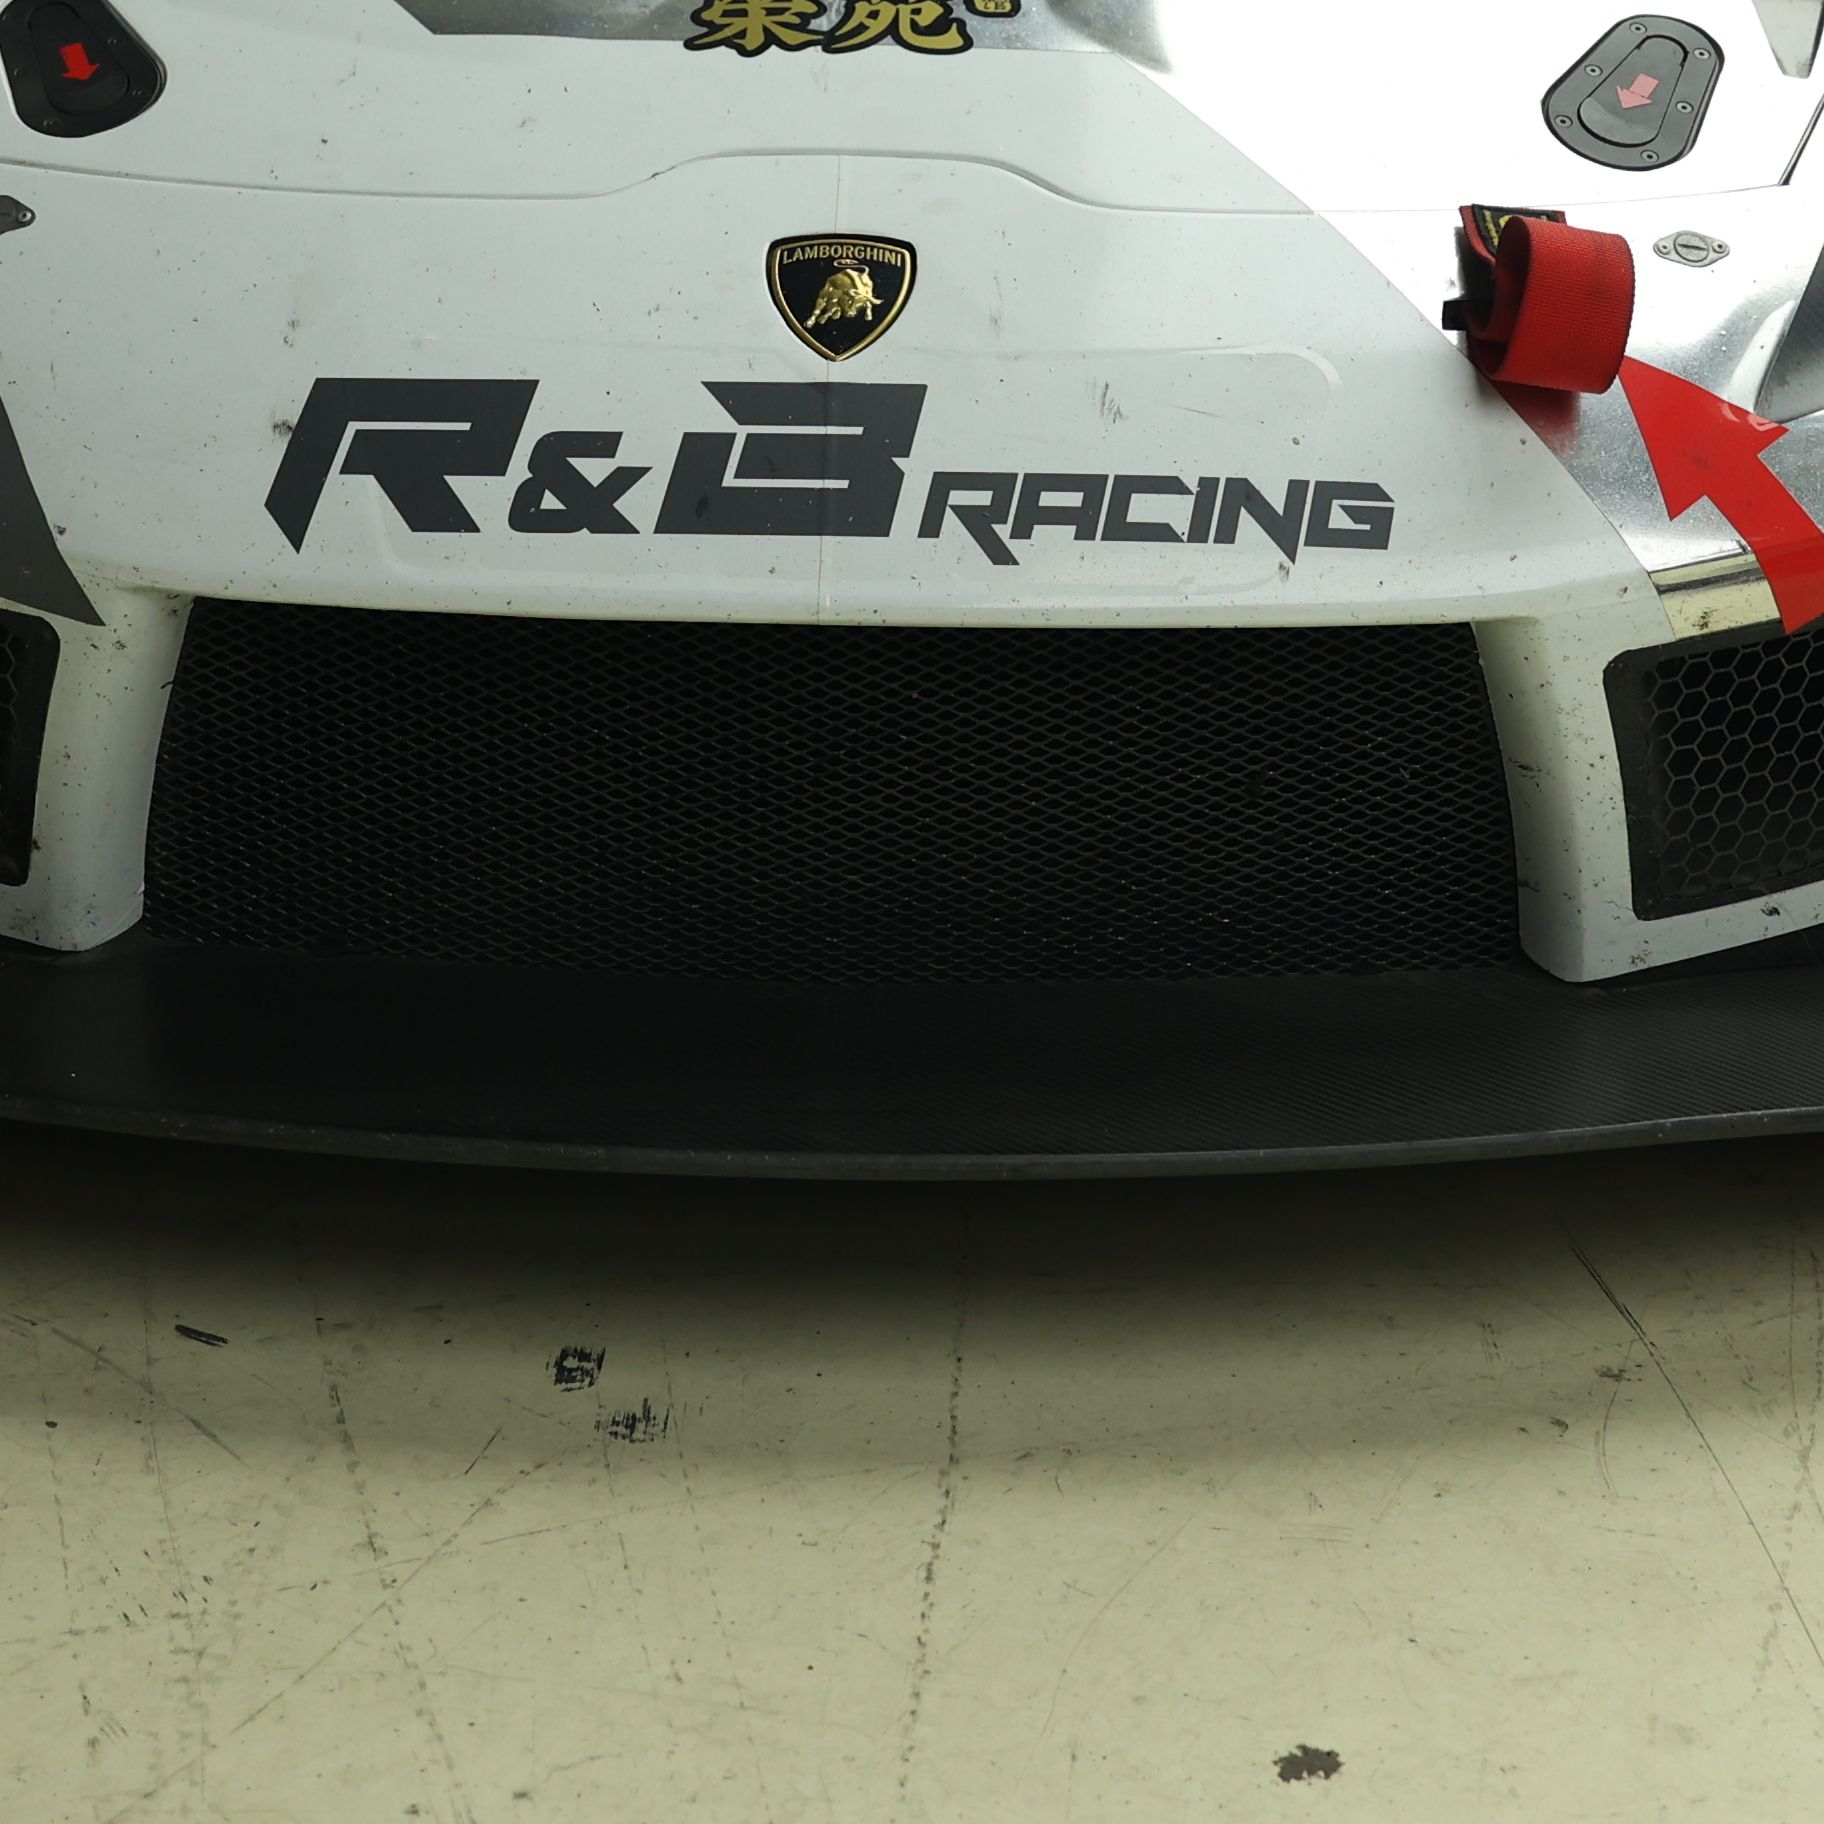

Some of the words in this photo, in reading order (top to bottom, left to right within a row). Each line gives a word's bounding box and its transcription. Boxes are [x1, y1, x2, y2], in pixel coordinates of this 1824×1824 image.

[781, 244, 902, 268] LAMBORGHINI
[263, 376, 928, 554] R&B
[916, 470, 1395, 566] RACING
